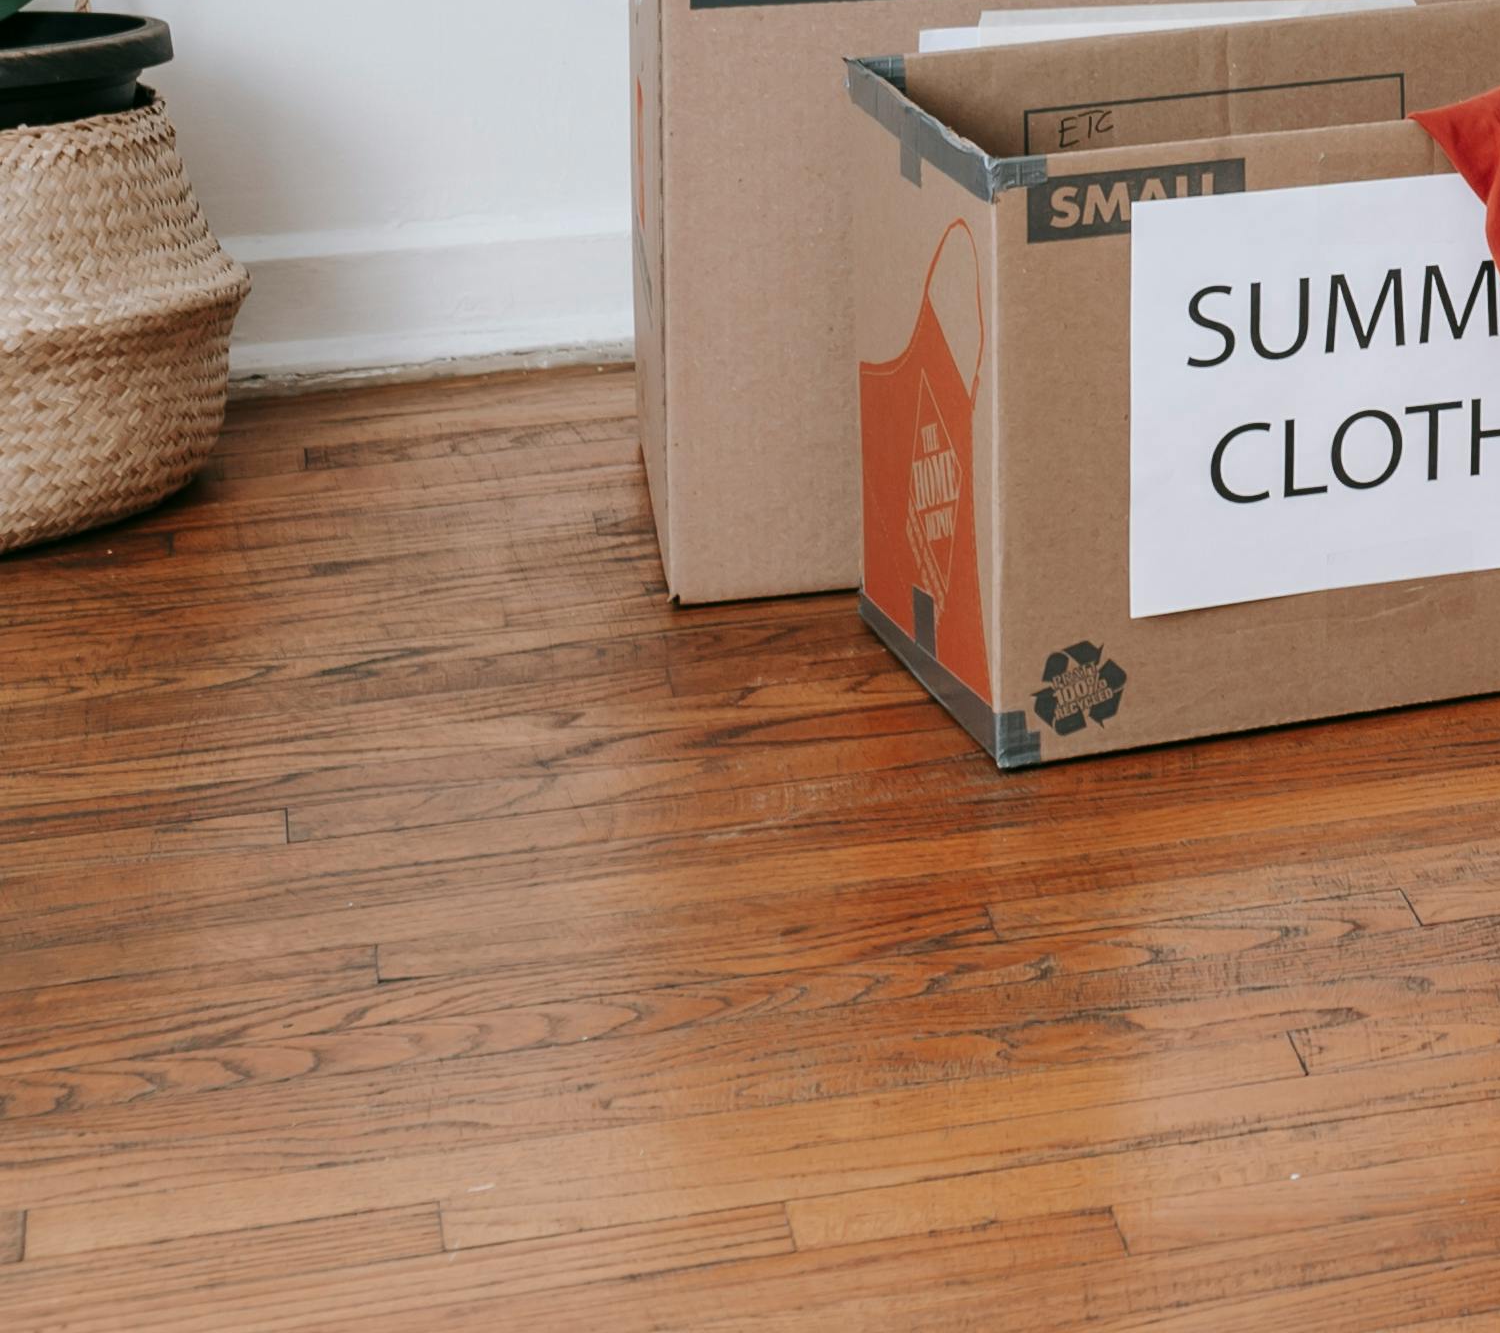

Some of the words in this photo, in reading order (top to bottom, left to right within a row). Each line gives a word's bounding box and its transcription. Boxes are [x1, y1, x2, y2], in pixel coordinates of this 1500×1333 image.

[1058, 110, 1114, 149] ETC
[921, 423, 940, 454] THE
[912, 447, 959, 511] HOME
[924, 506, 953, 542] DEPOT
[1054, 688, 1113, 720] RECYCLED
[1055, 676, 1108, 706] 100%
